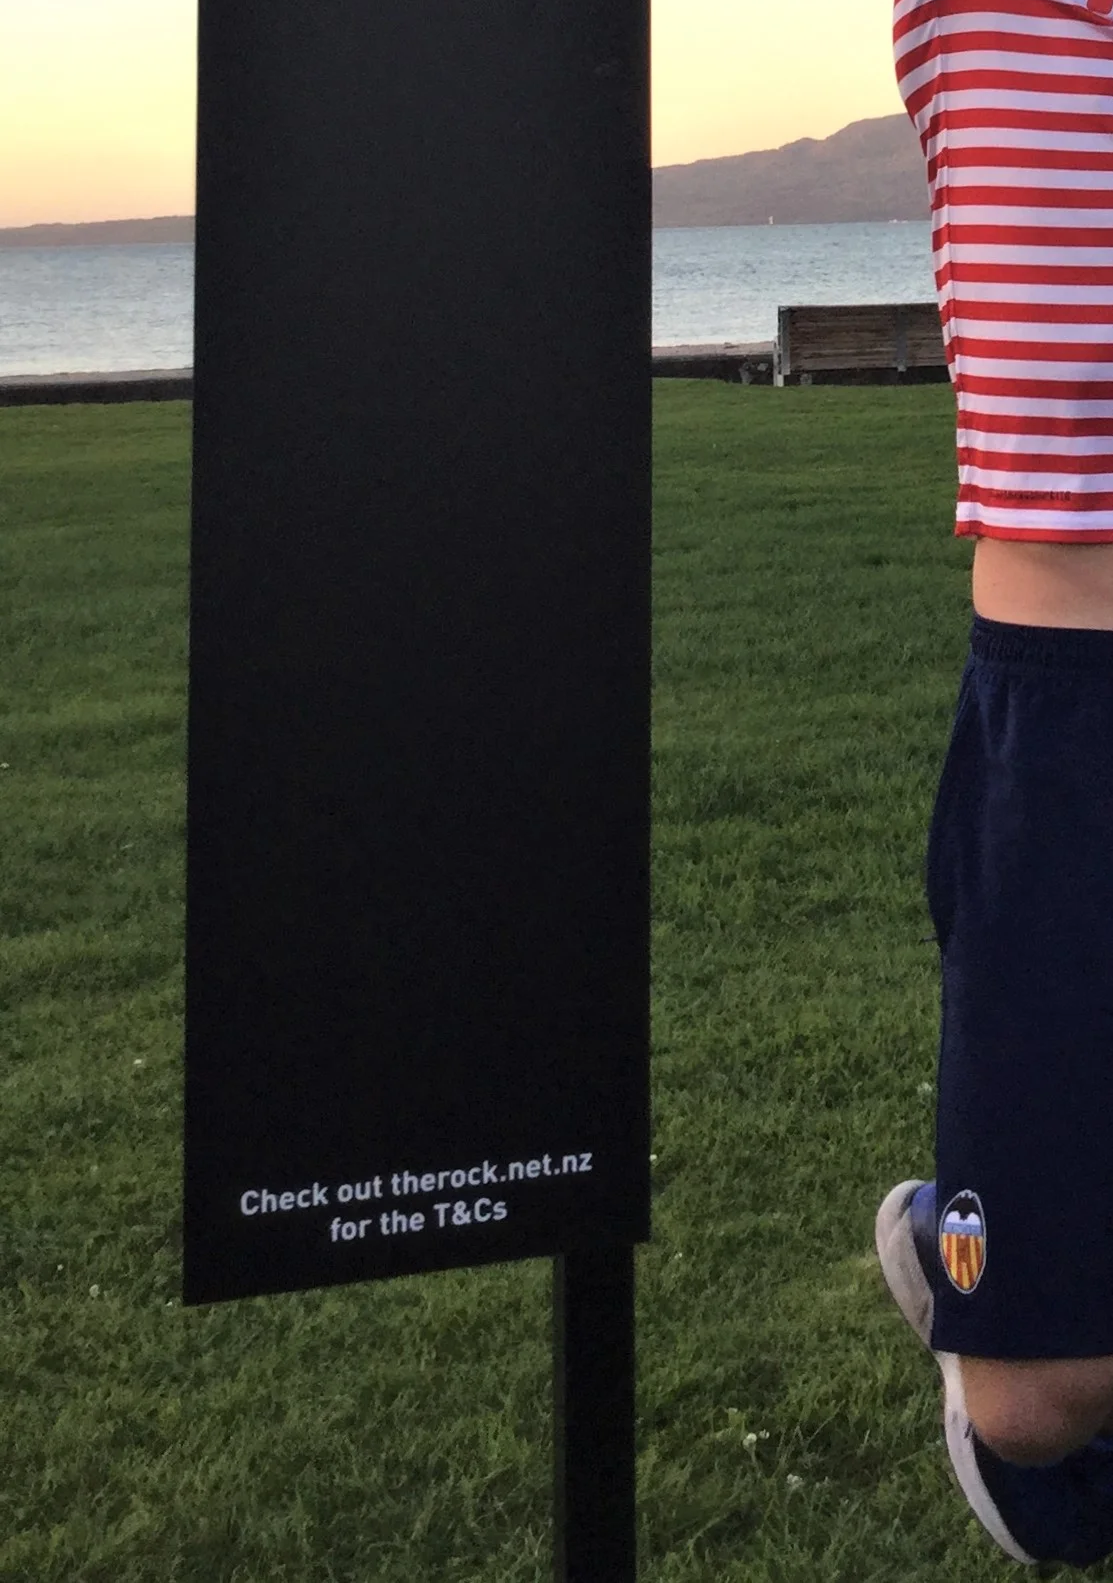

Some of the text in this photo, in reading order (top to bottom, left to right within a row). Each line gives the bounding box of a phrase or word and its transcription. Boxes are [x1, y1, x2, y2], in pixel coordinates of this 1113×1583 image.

[240, 1151, 593, 1216] Check out therock.net.nz
[330, 1197, 508, 1243] for the T&Cs
